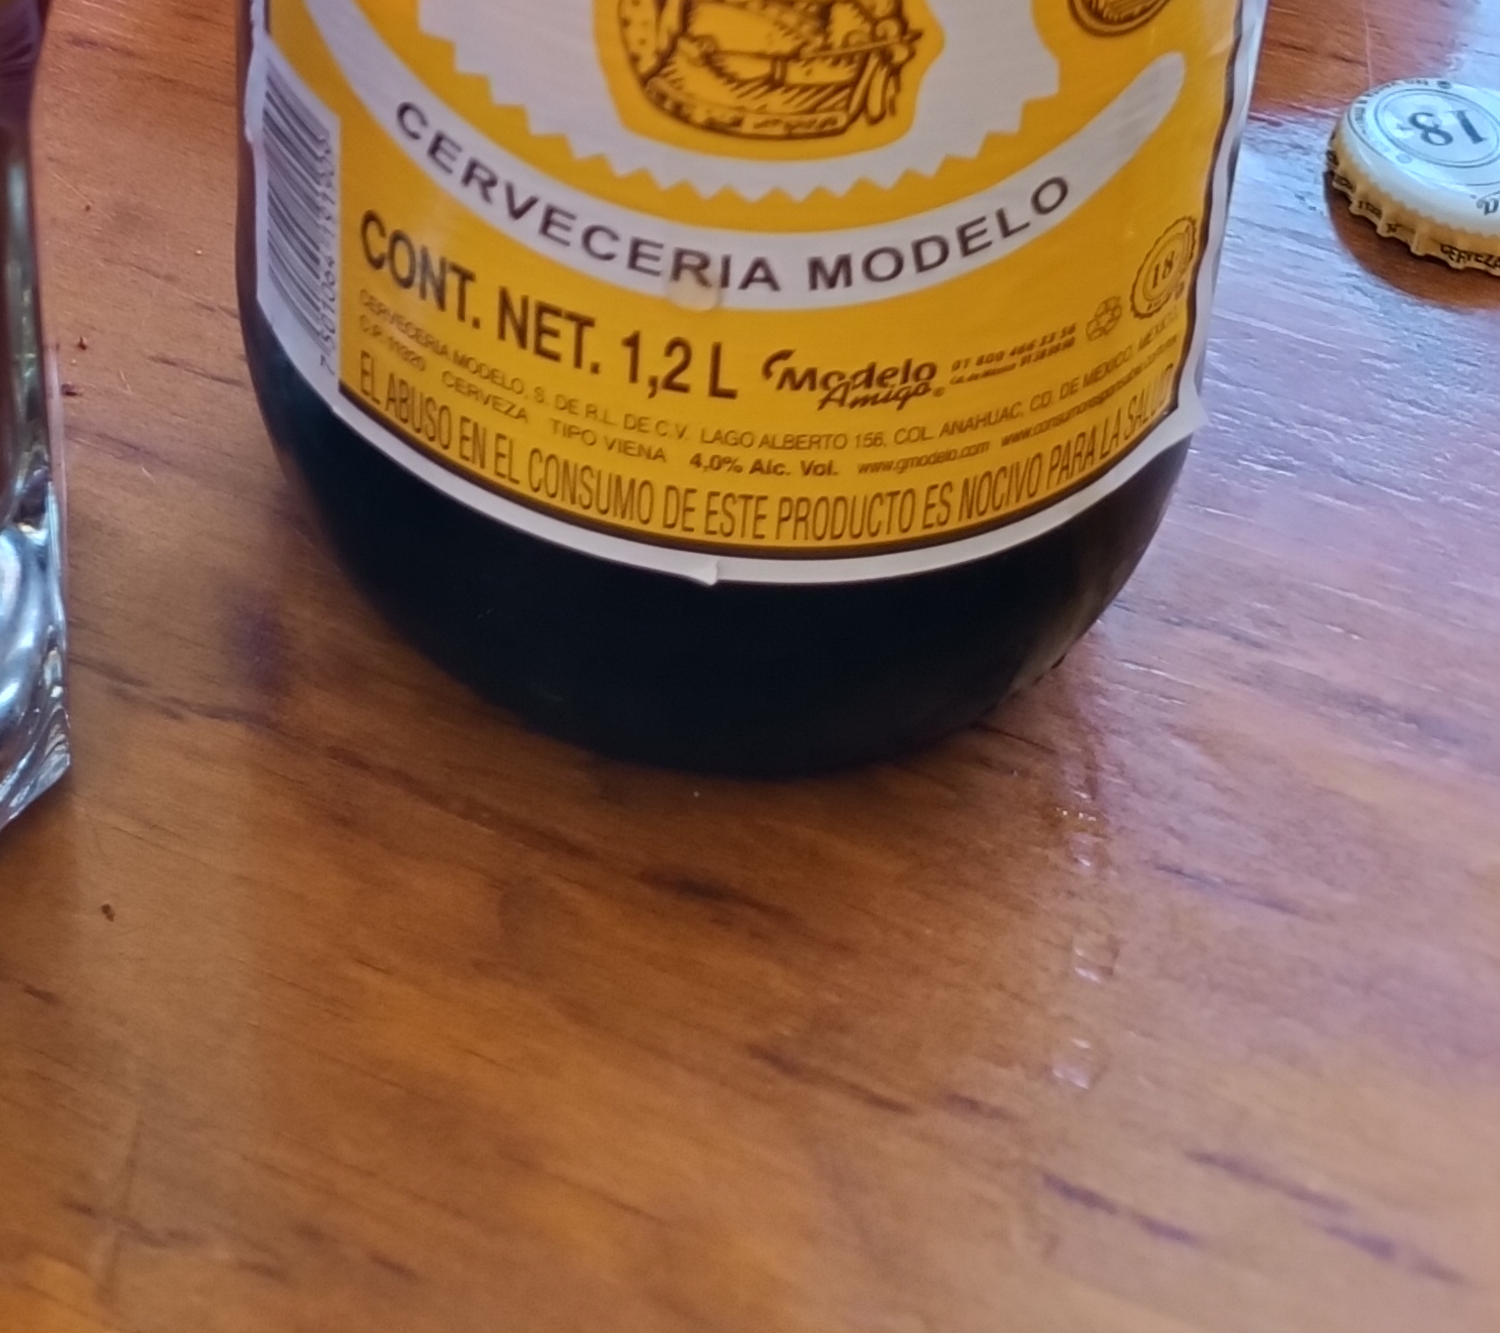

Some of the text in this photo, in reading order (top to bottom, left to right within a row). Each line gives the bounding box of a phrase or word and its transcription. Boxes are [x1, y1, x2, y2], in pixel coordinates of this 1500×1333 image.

[395, 101, 782, 293] CERVECERIA
[807, 175, 1071, 292] MODELO
[359, 209, 738, 400] CONT. NET. 1,2 L
[441, 369, 529, 424] CERVEZA
[550, 417, 598, 447] TIPO
[603, 434, 668, 464] VIENA
[748, 457, 792, 477] Alc.
[798, 458, 840, 478] Vol.
[554, 393, 580, 416] DE
[623, 413, 650, 434] DE
[700, 427, 755, 449] LAGO
[757, 432, 849, 451] ALBERTO
[1058, 375, 1081, 400] DE
[761, 348, 938, 392] Modelo
[816, 381, 933, 412] Amigo
[359, 349, 382, 406] EL
[384, 371, 453, 451] ABUSO
[458, 414, 487, 470] EN
[493, 432, 521, 486] EL
[527, 447, 655, 526] CONSUMO
[661, 483, 698, 534] DE
[703, 489, 769, 541] ESTE
[774, 487, 917, 542] PRODUCTO
[921, 479, 954, 531] ES
[957, 451, 1044, 523] NOCIVO
[1045, 424, 1097, 491] PARA
[1099, 406, 1122, 461] LA
